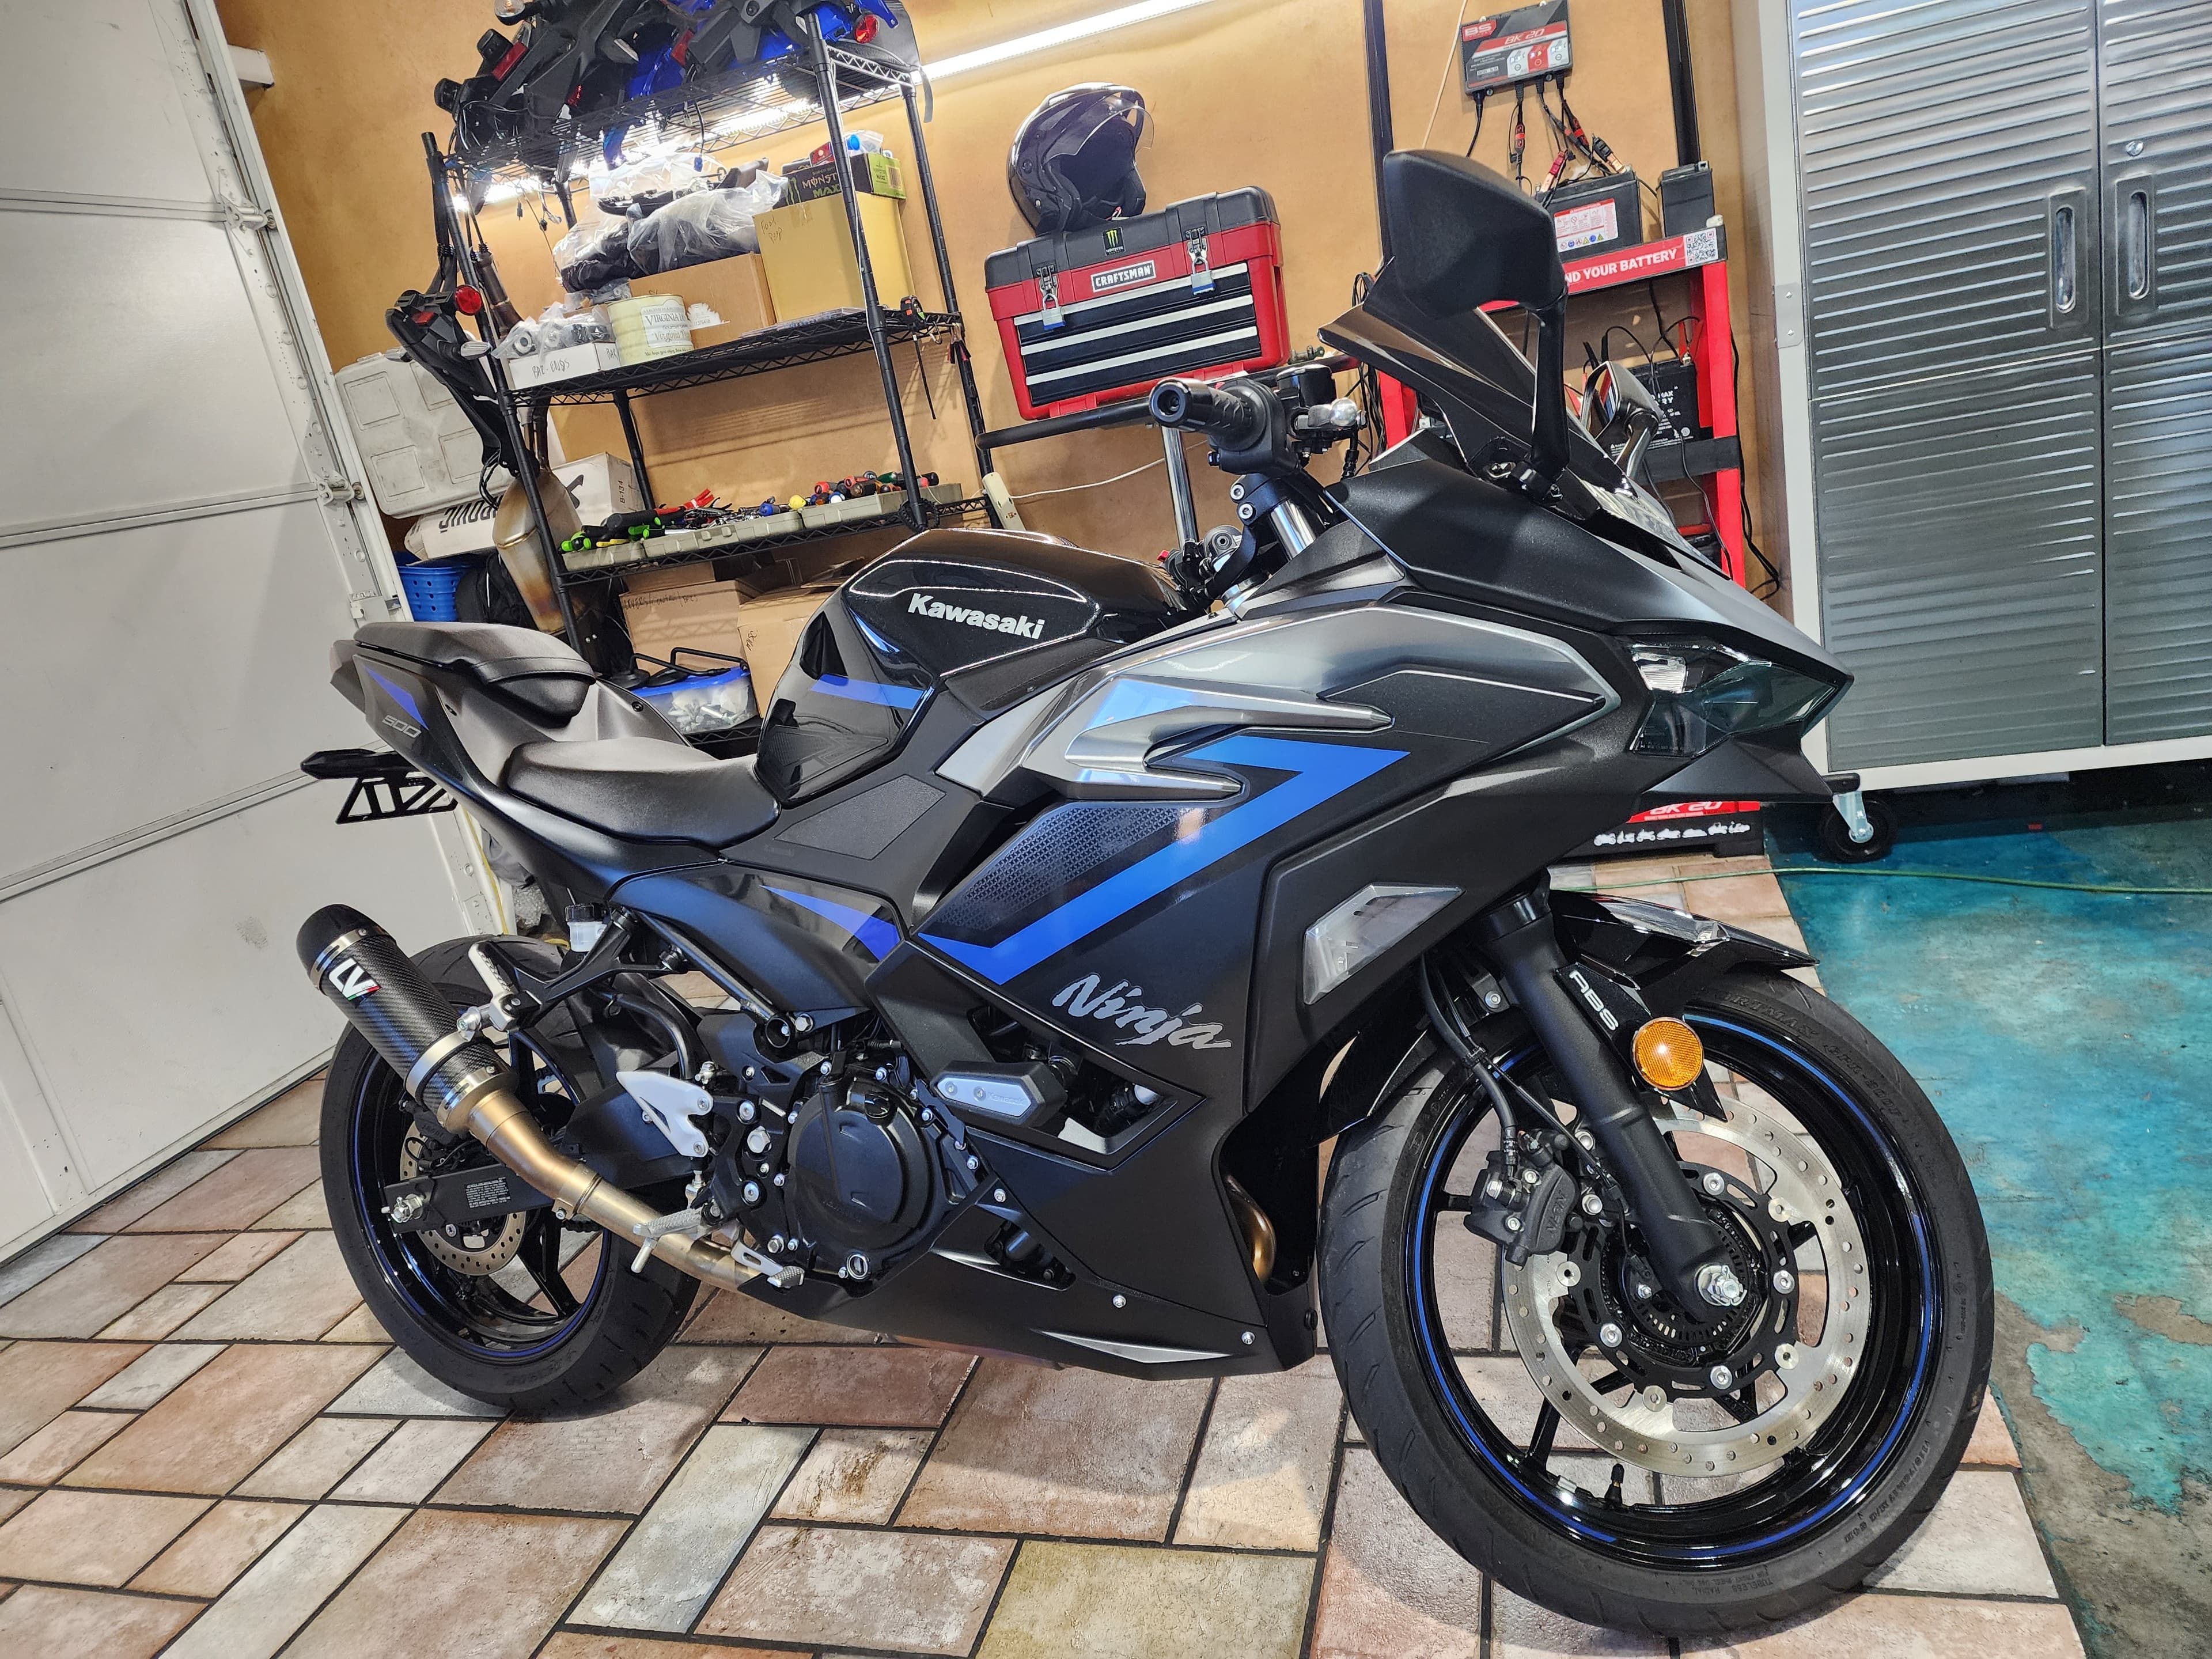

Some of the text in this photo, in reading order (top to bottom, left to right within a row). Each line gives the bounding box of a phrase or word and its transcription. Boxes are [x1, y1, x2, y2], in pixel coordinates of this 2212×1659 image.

[1465, 23, 1492, 36] BS
[1504, 35, 1521, 45] BK
[1525, 29, 1545, 39] 20
[1095, 263, 1152, 287] CRAFTSMAN
[1584, 263, 1618, 279] YOUR
[1619, 248, 1677, 272] BATTERY
[645, 312, 680, 327] VIRGINIA
[617, 479, 626, 504] B-134
[907, 593, 1046, 640] Kawasaki
[382, 714, 422, 738] 500
[1688, 801, 1724, 811] 20
[328, 957, 378, 998] LV
[1051, 974, 1232, 1050] Ninja
[1569, 970, 1619, 1031] ABS
